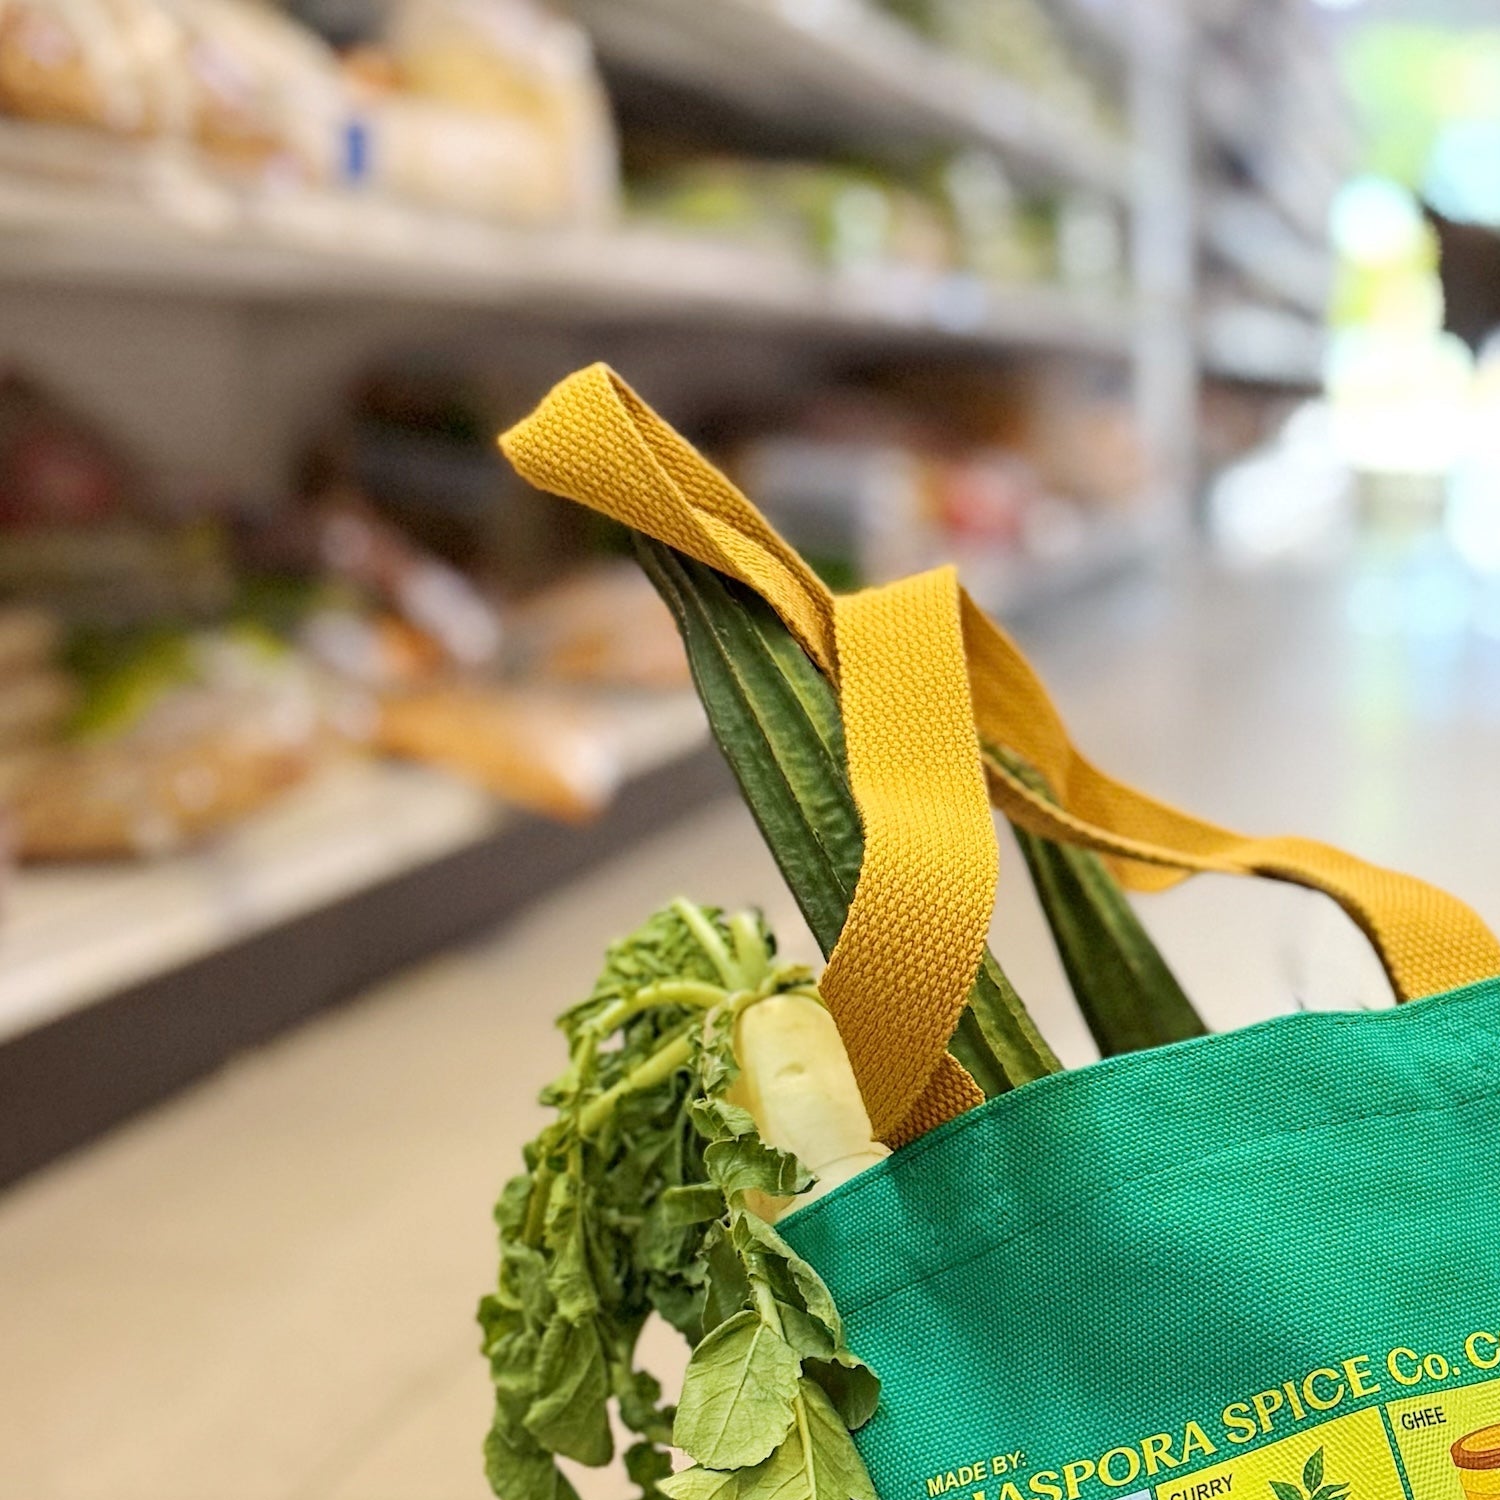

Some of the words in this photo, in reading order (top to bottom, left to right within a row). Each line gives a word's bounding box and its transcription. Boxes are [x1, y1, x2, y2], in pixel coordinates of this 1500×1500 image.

[1221, 1354, 1379, 1445] SPICE
[1387, 1346, 1462, 1386] Co.
[1401, 1406, 1448, 1432] GHEE
[927, 1461, 988, 1499] MADE
[992, 1449, 1028, 1482] BY:
